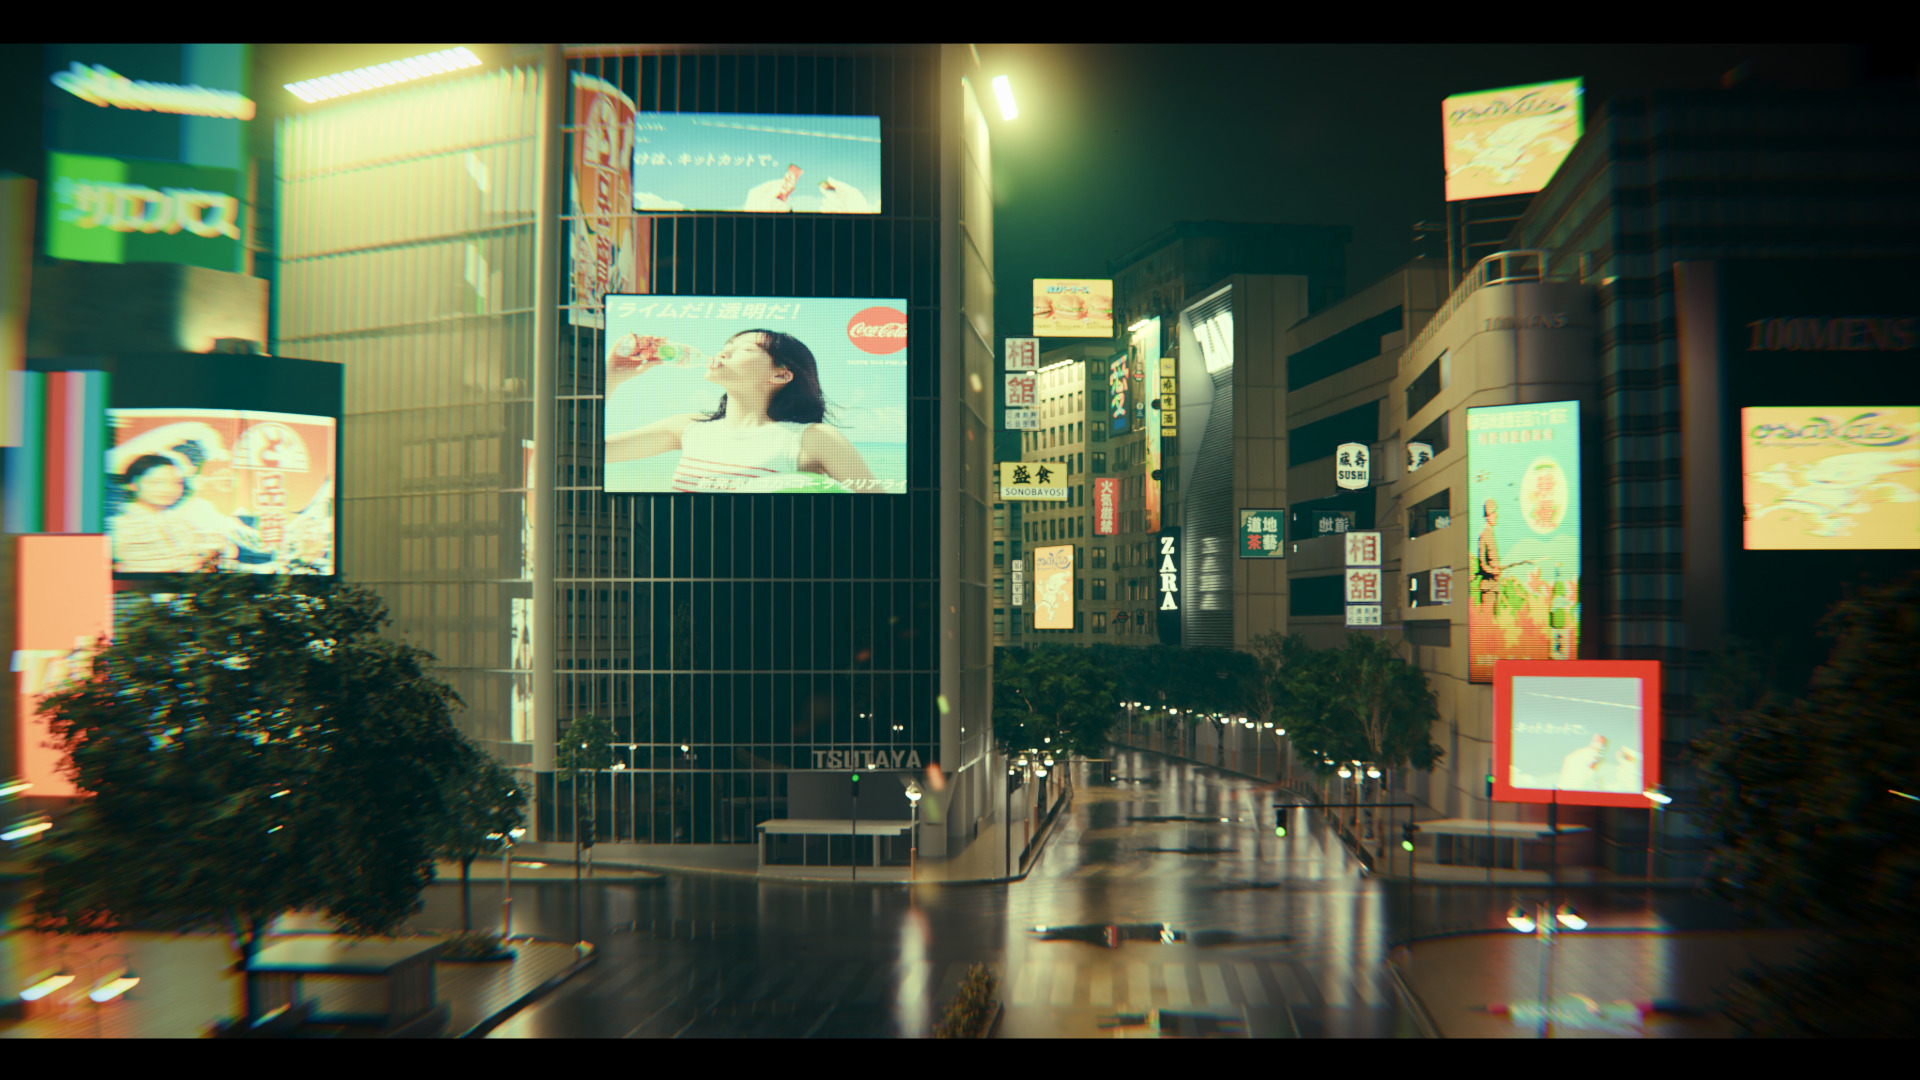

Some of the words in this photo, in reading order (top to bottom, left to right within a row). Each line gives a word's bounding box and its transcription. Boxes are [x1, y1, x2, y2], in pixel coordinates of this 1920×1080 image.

[1338, 470, 1367, 480] SUSHI
[1005, 487, 1065, 497] SONOBAYOSI
[1247, 516, 1277, 533] 道地
[1159, 536, 1179, 611] ZARA
[812, 750, 922, 769] TSUTAYA
